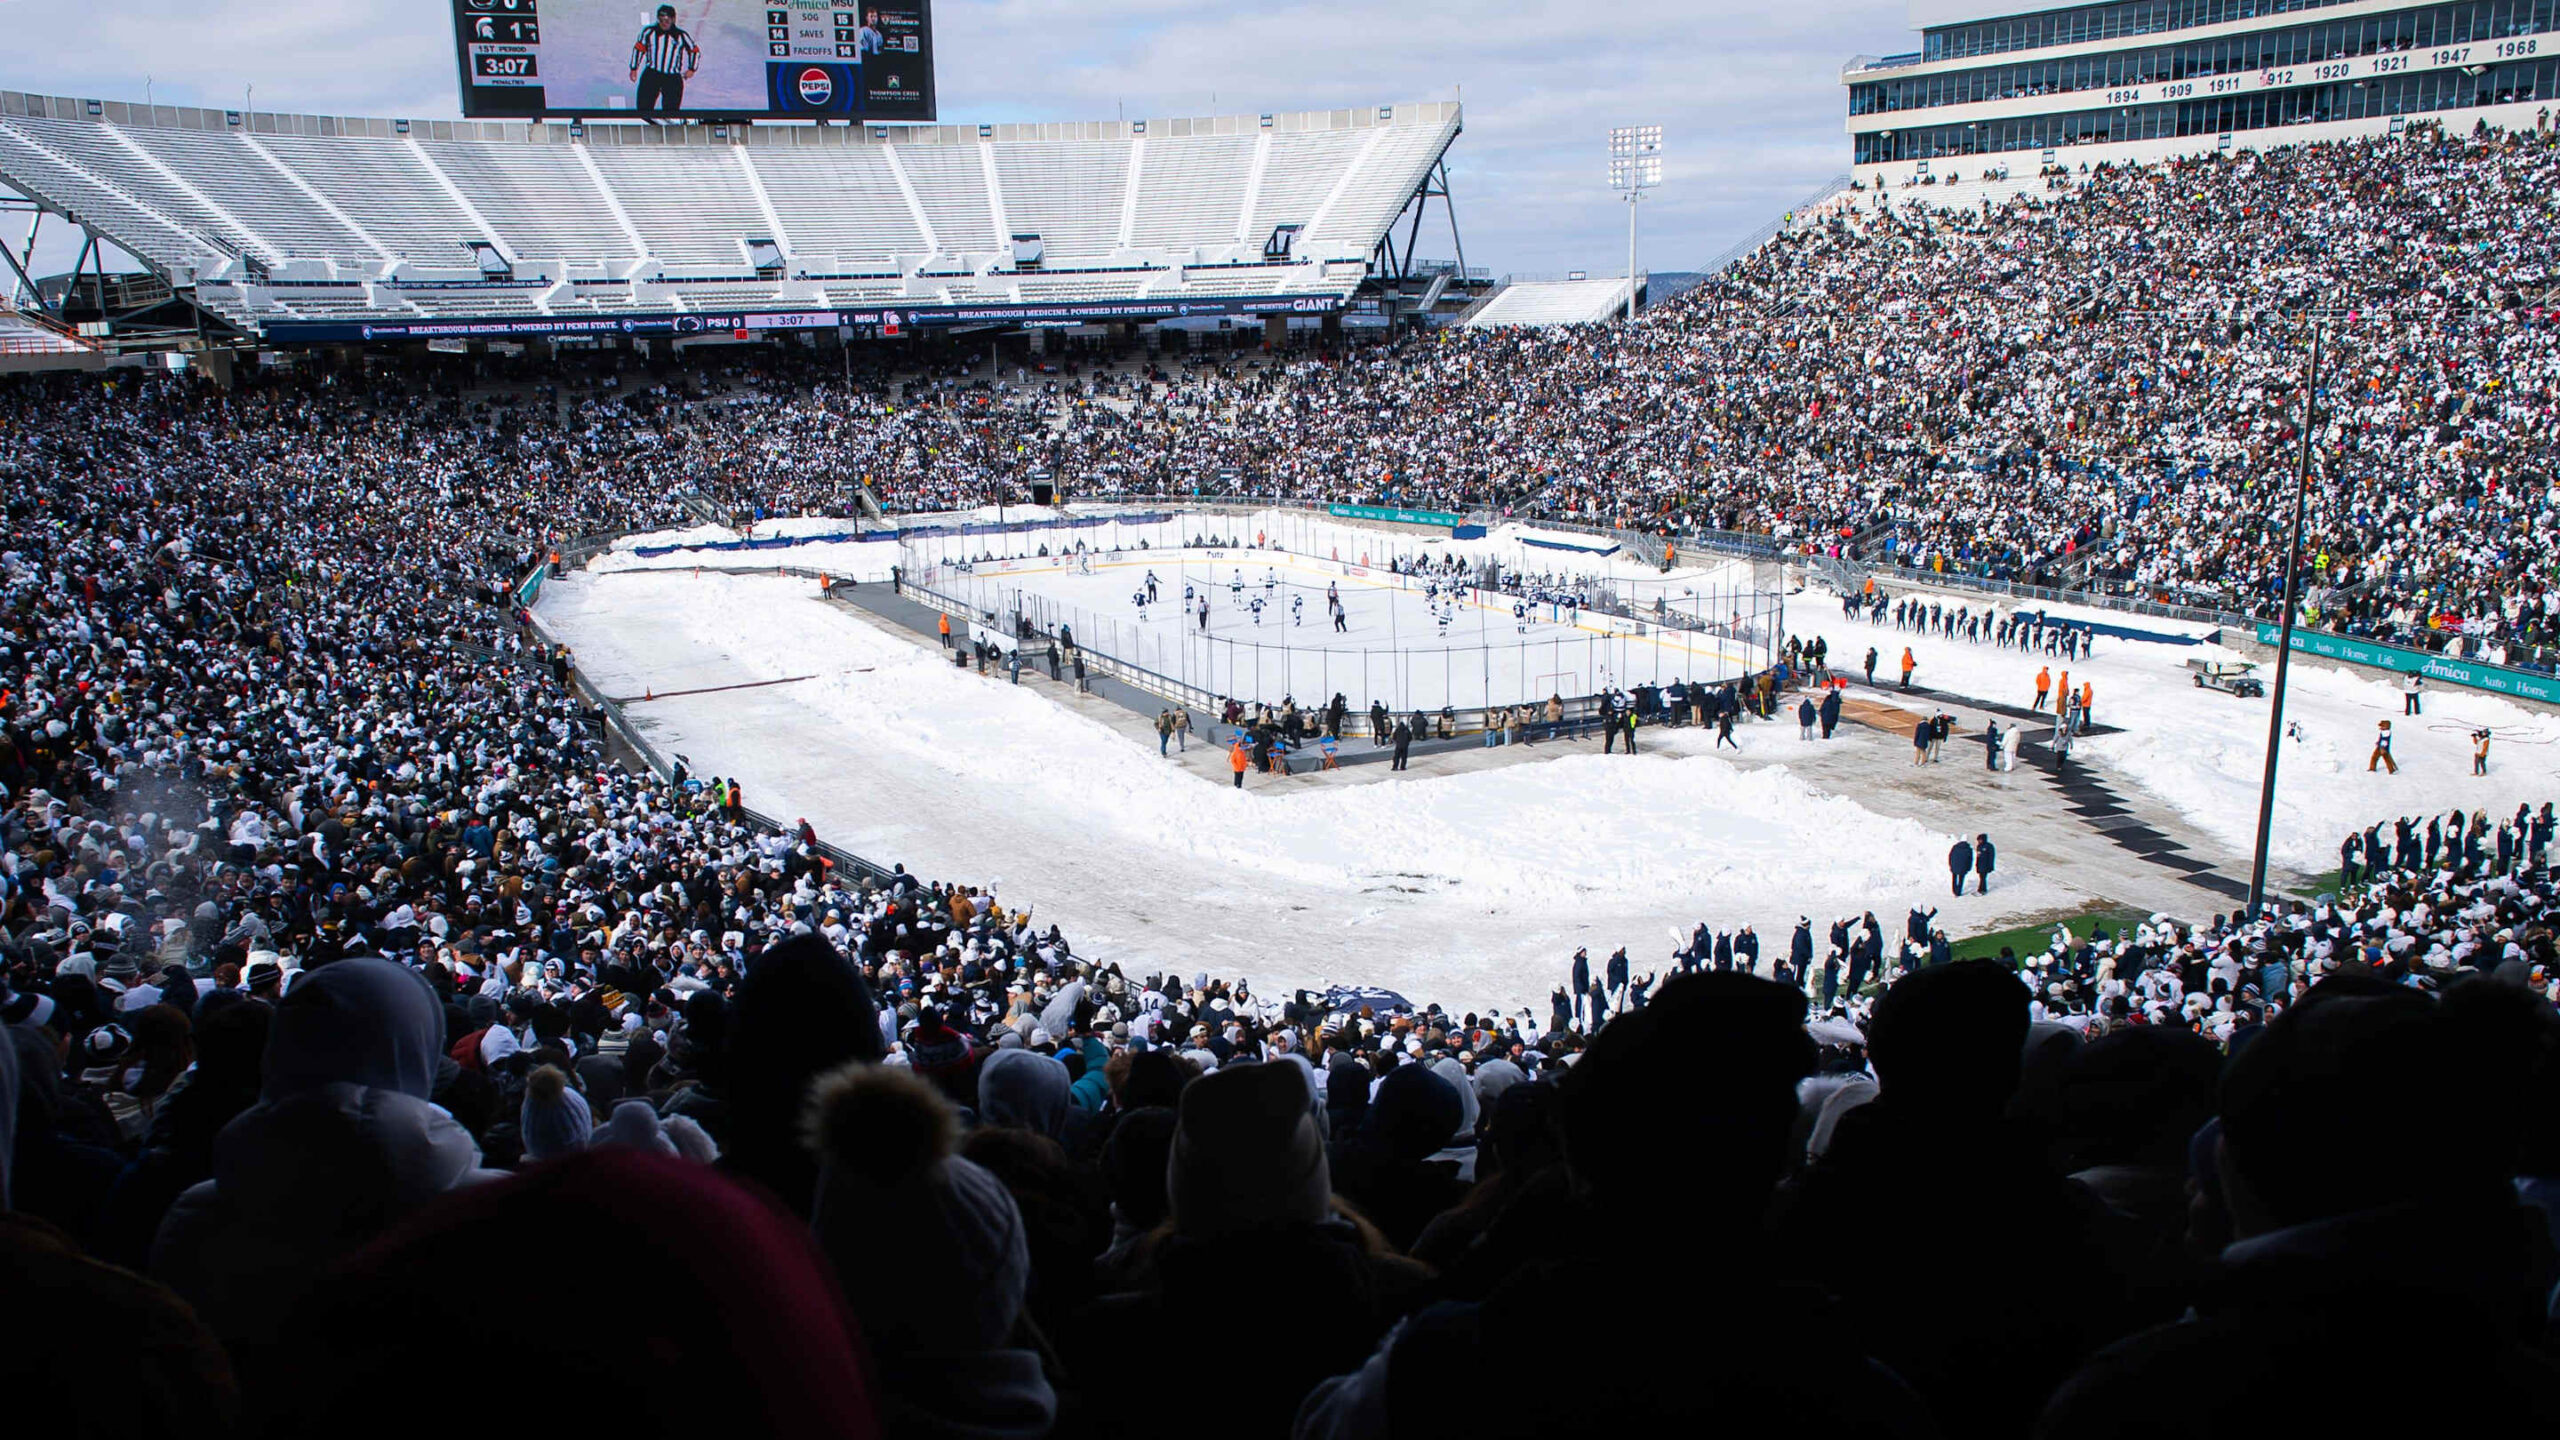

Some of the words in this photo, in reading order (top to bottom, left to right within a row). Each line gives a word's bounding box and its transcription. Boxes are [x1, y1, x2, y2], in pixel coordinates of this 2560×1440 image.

[772, 13, 781, 24] 7
[802, 13, 819, 21] SOG
[836, 14, 849, 25] 15
[510, 22, 521, 40] 1
[772, 29, 784, 39] 14
[800, 30, 824, 38] SAVES
[840, 31, 848, 41] 7
[478, 45, 495, 53] 1ST
[773, 45, 786, 55] 13
[793, 47, 833, 56] FACEOFFS
[838, 46, 852, 57] 14
[2496, 40, 2537, 58] 1968
[2432, 48, 2471, 65] 1947
[485, 58, 529, 75] 3:07
[2372, 55, 2408, 73] 1921
[2262, 70, 2294, 86] 912
[2314, 63, 2350, 80] 1920
[801, 82, 830, 91] PEPSI
[2161, 83, 2193, 98] 1909
[2209, 77, 2240, 93] 1911
[2106, 89, 2140, 104] 1894
[1293, 298, 1334, 311] GIANT
[841, 314, 849, 325] 1
[854, 314, 878, 324] MSU
[958, 310, 1025, 319] BREAKTHROUGH
[1070, 307, 1111, 316] POWERED
[1112, 306, 1123, 315] BY
[1123, 306, 1146, 314] PENN
[408, 325, 469, 335] BREAKTHROUGH
[512, 322, 553, 332] POWERED
[554, 322, 565, 331] BY
[566, 321, 589, 330] PENN
[707, 318, 729, 328] PSU
[732, 317, 741, 328] 0
[779, 316, 804, 326] 3:07
[2263, 627, 2305, 648] Aca
[2315, 641, 2335, 654] Auto
[2342, 646, 2369, 661] Home
[2377, 653, 2395, 667] Life
[2421, 659, 2471, 681] Amica
[2482, 675, 2508, 689] Auto
[2516, 680, 2549, 698] Home
[1144, 997, 1160, 1011] 14
